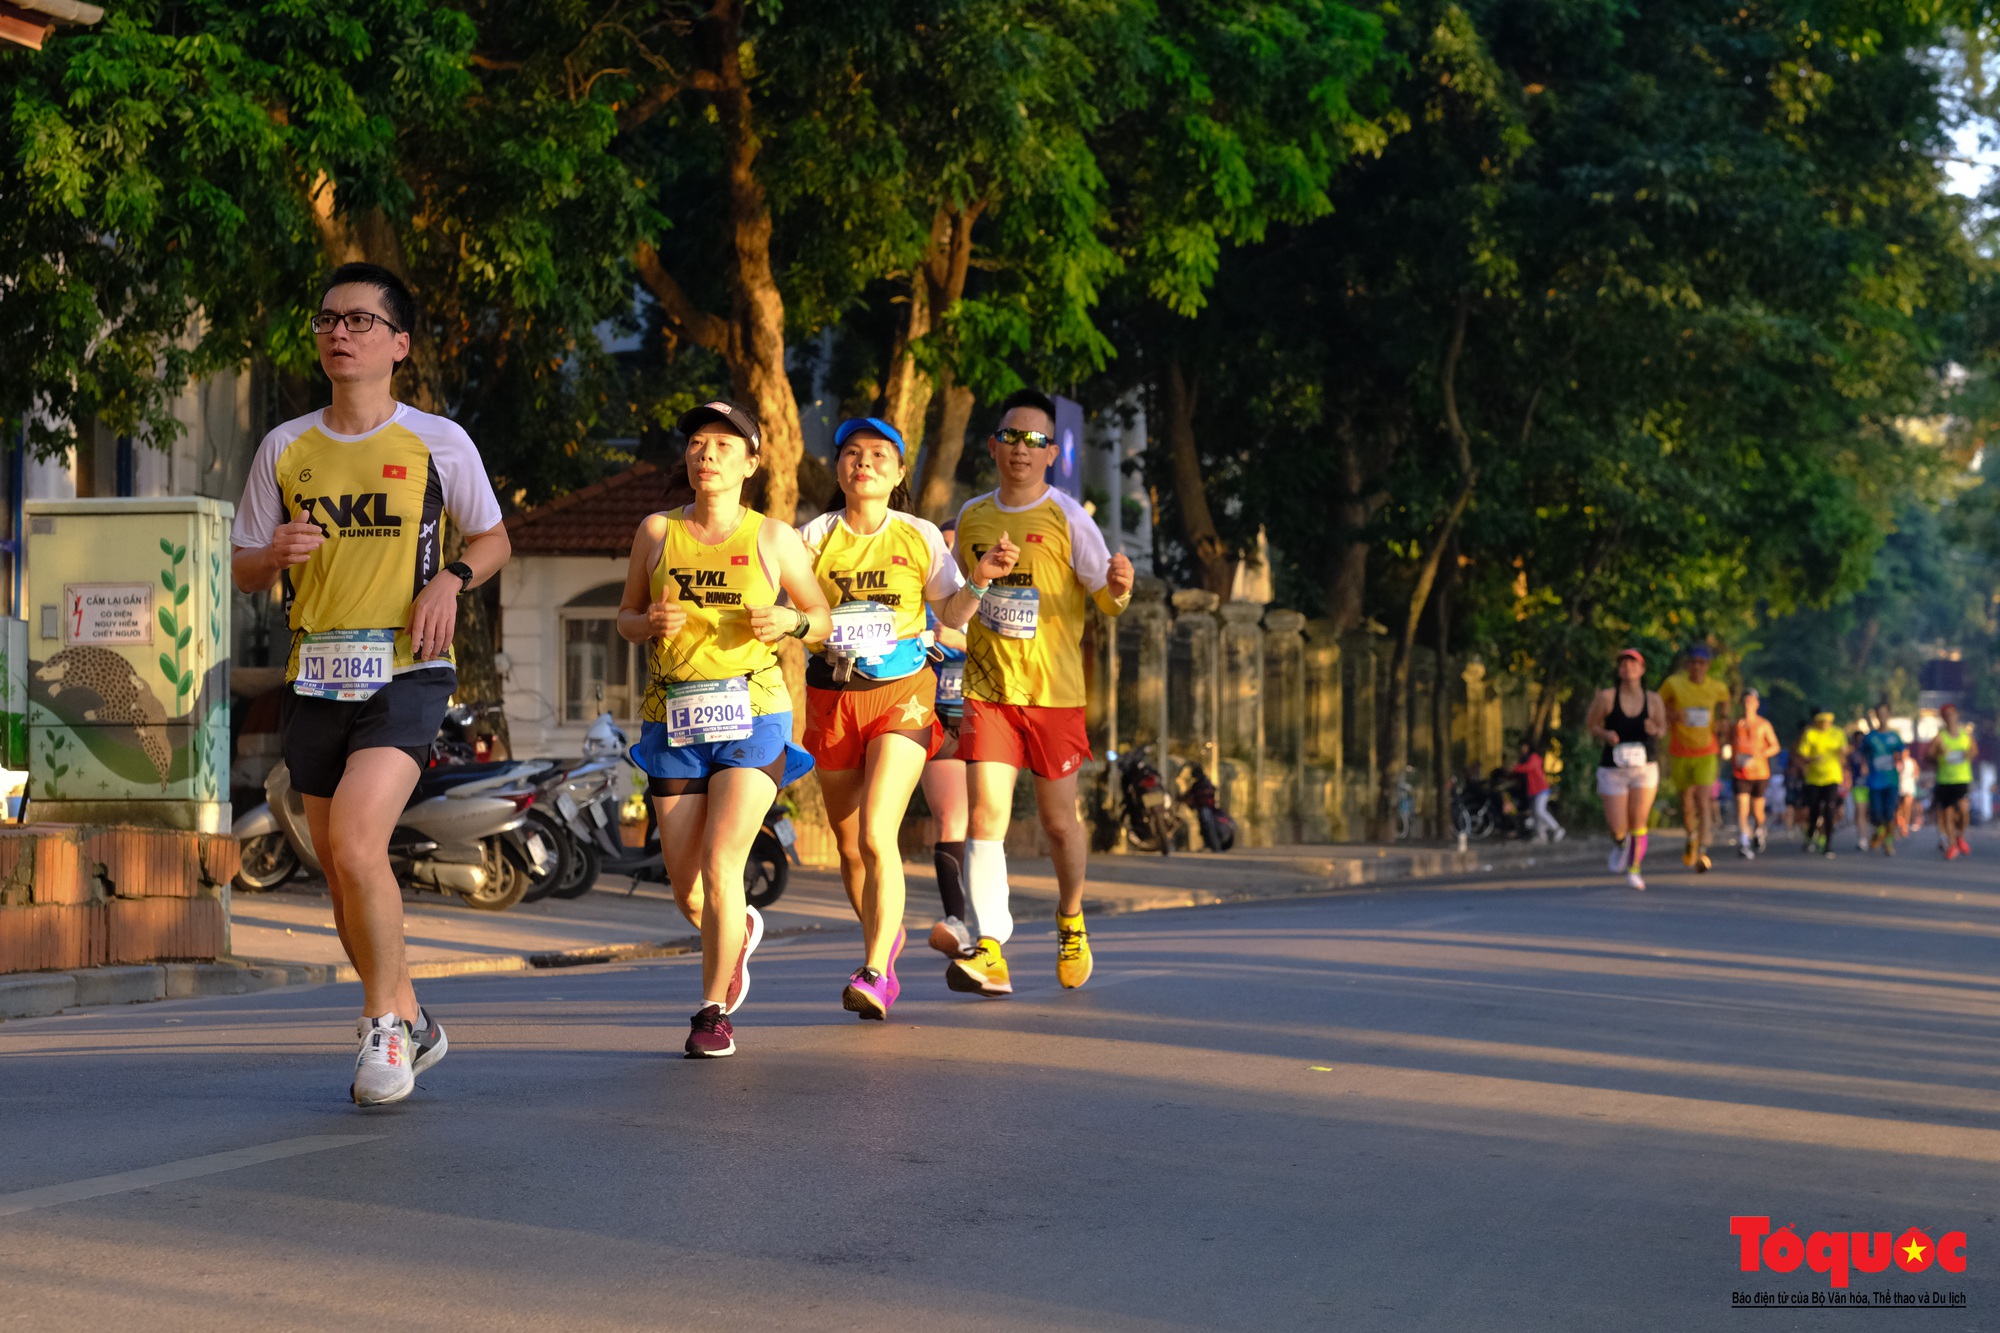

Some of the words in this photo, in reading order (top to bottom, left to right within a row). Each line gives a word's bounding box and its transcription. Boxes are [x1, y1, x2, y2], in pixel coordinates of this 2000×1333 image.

[317, 493, 402, 528] VKL
[340, 528, 401, 538] RUNNERS
[695, 570, 728, 587] VKL
[856, 571, 888, 589] VKL
[107, 596, 122, 607] LẠI
[705, 591, 742, 605] RUNNERS
[993, 605, 1034, 623] 23040
[94, 620, 117, 628] NGUY
[847, 622, 892, 641] 24879
[92, 629, 113, 638] CHẾT
[307, 657, 323, 679] M
[332, 657, 382, 678] 21841
[674, 708, 688, 728] F
[693, 703, 745, 725] 29304
[749, 746, 765, 760] T8
